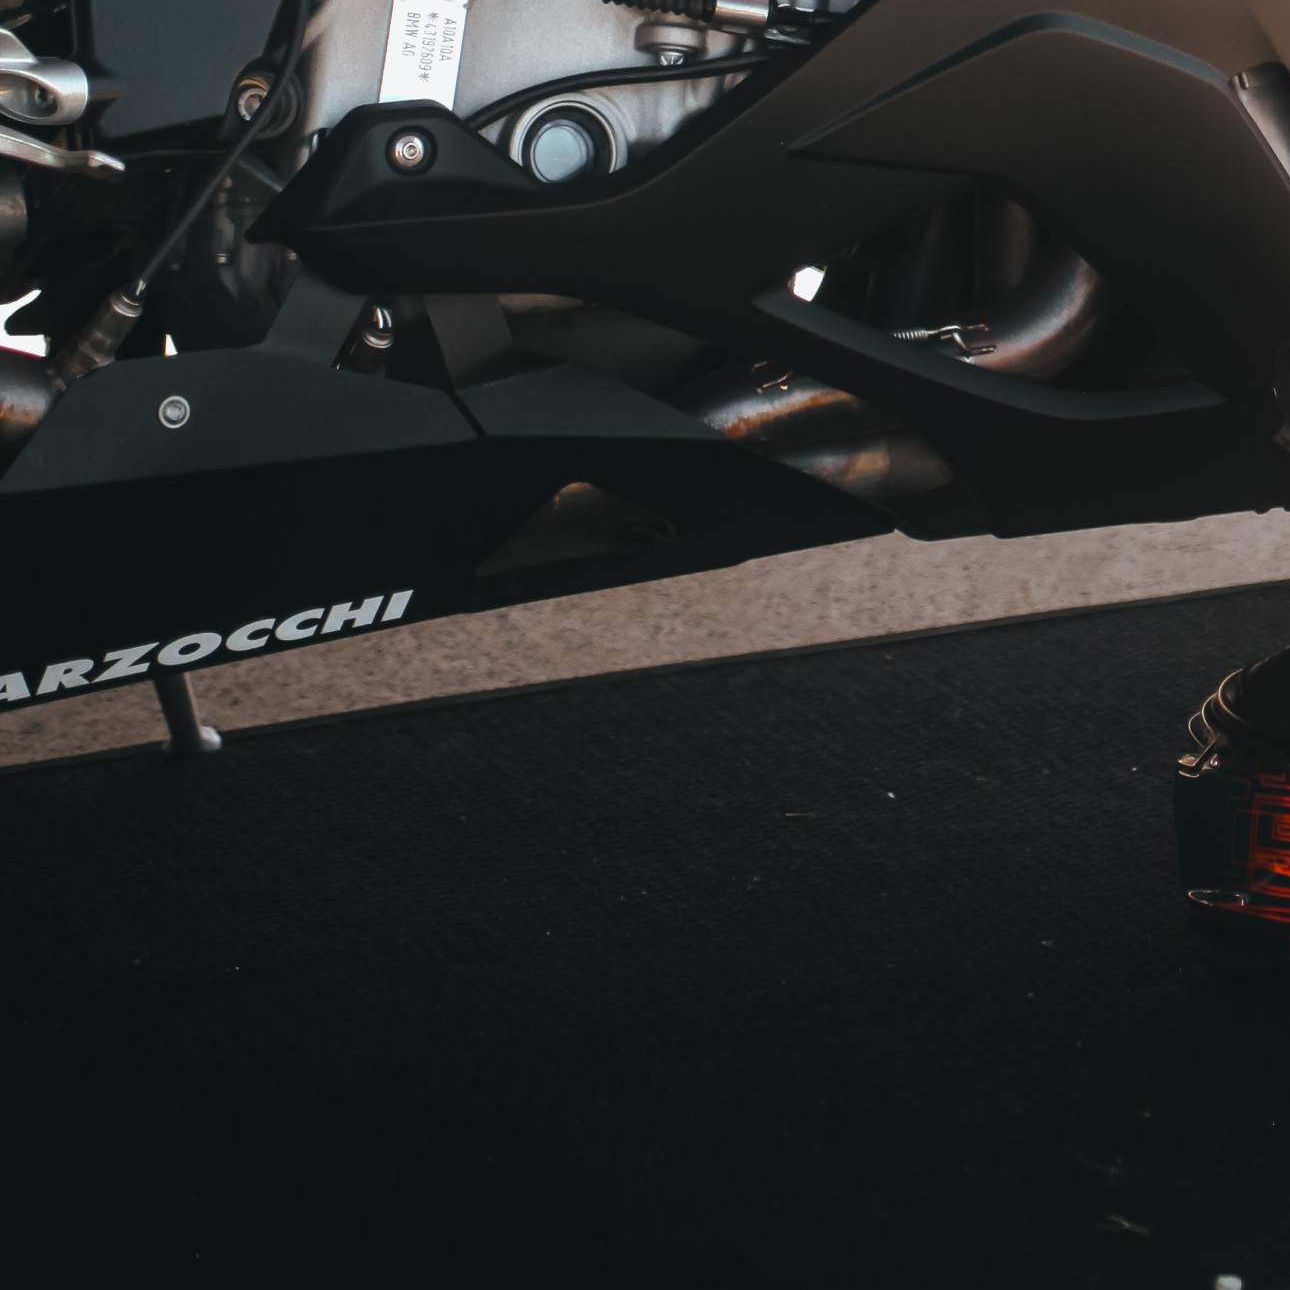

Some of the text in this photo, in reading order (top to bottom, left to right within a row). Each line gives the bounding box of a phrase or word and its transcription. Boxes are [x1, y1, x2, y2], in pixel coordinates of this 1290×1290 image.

[401, 12, 421, 57] BMW AG
[439, 17, 457, 61] A10A10A
